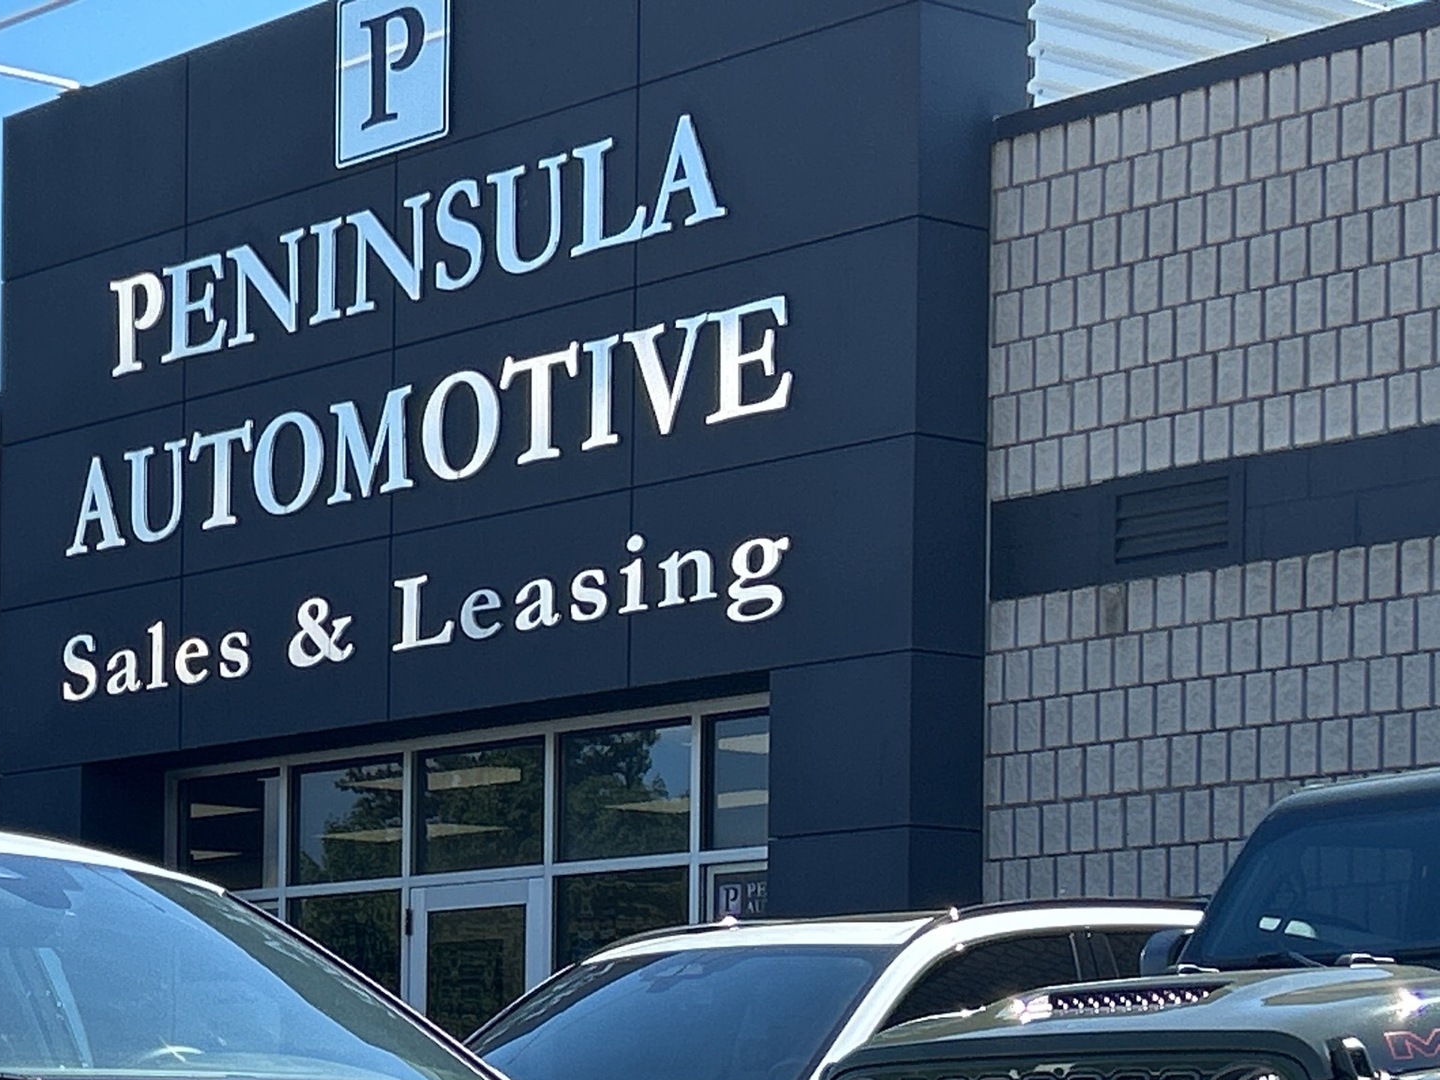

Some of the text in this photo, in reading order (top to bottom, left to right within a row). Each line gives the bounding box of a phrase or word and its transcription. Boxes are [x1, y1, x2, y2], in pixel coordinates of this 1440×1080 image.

[360, 7, 425, 131] P
[110, 114, 727, 378] PENINSULA
[64, 295, 793, 557] AUTOMOTIVE
[63, 534, 791, 702] Sales & Leasing
